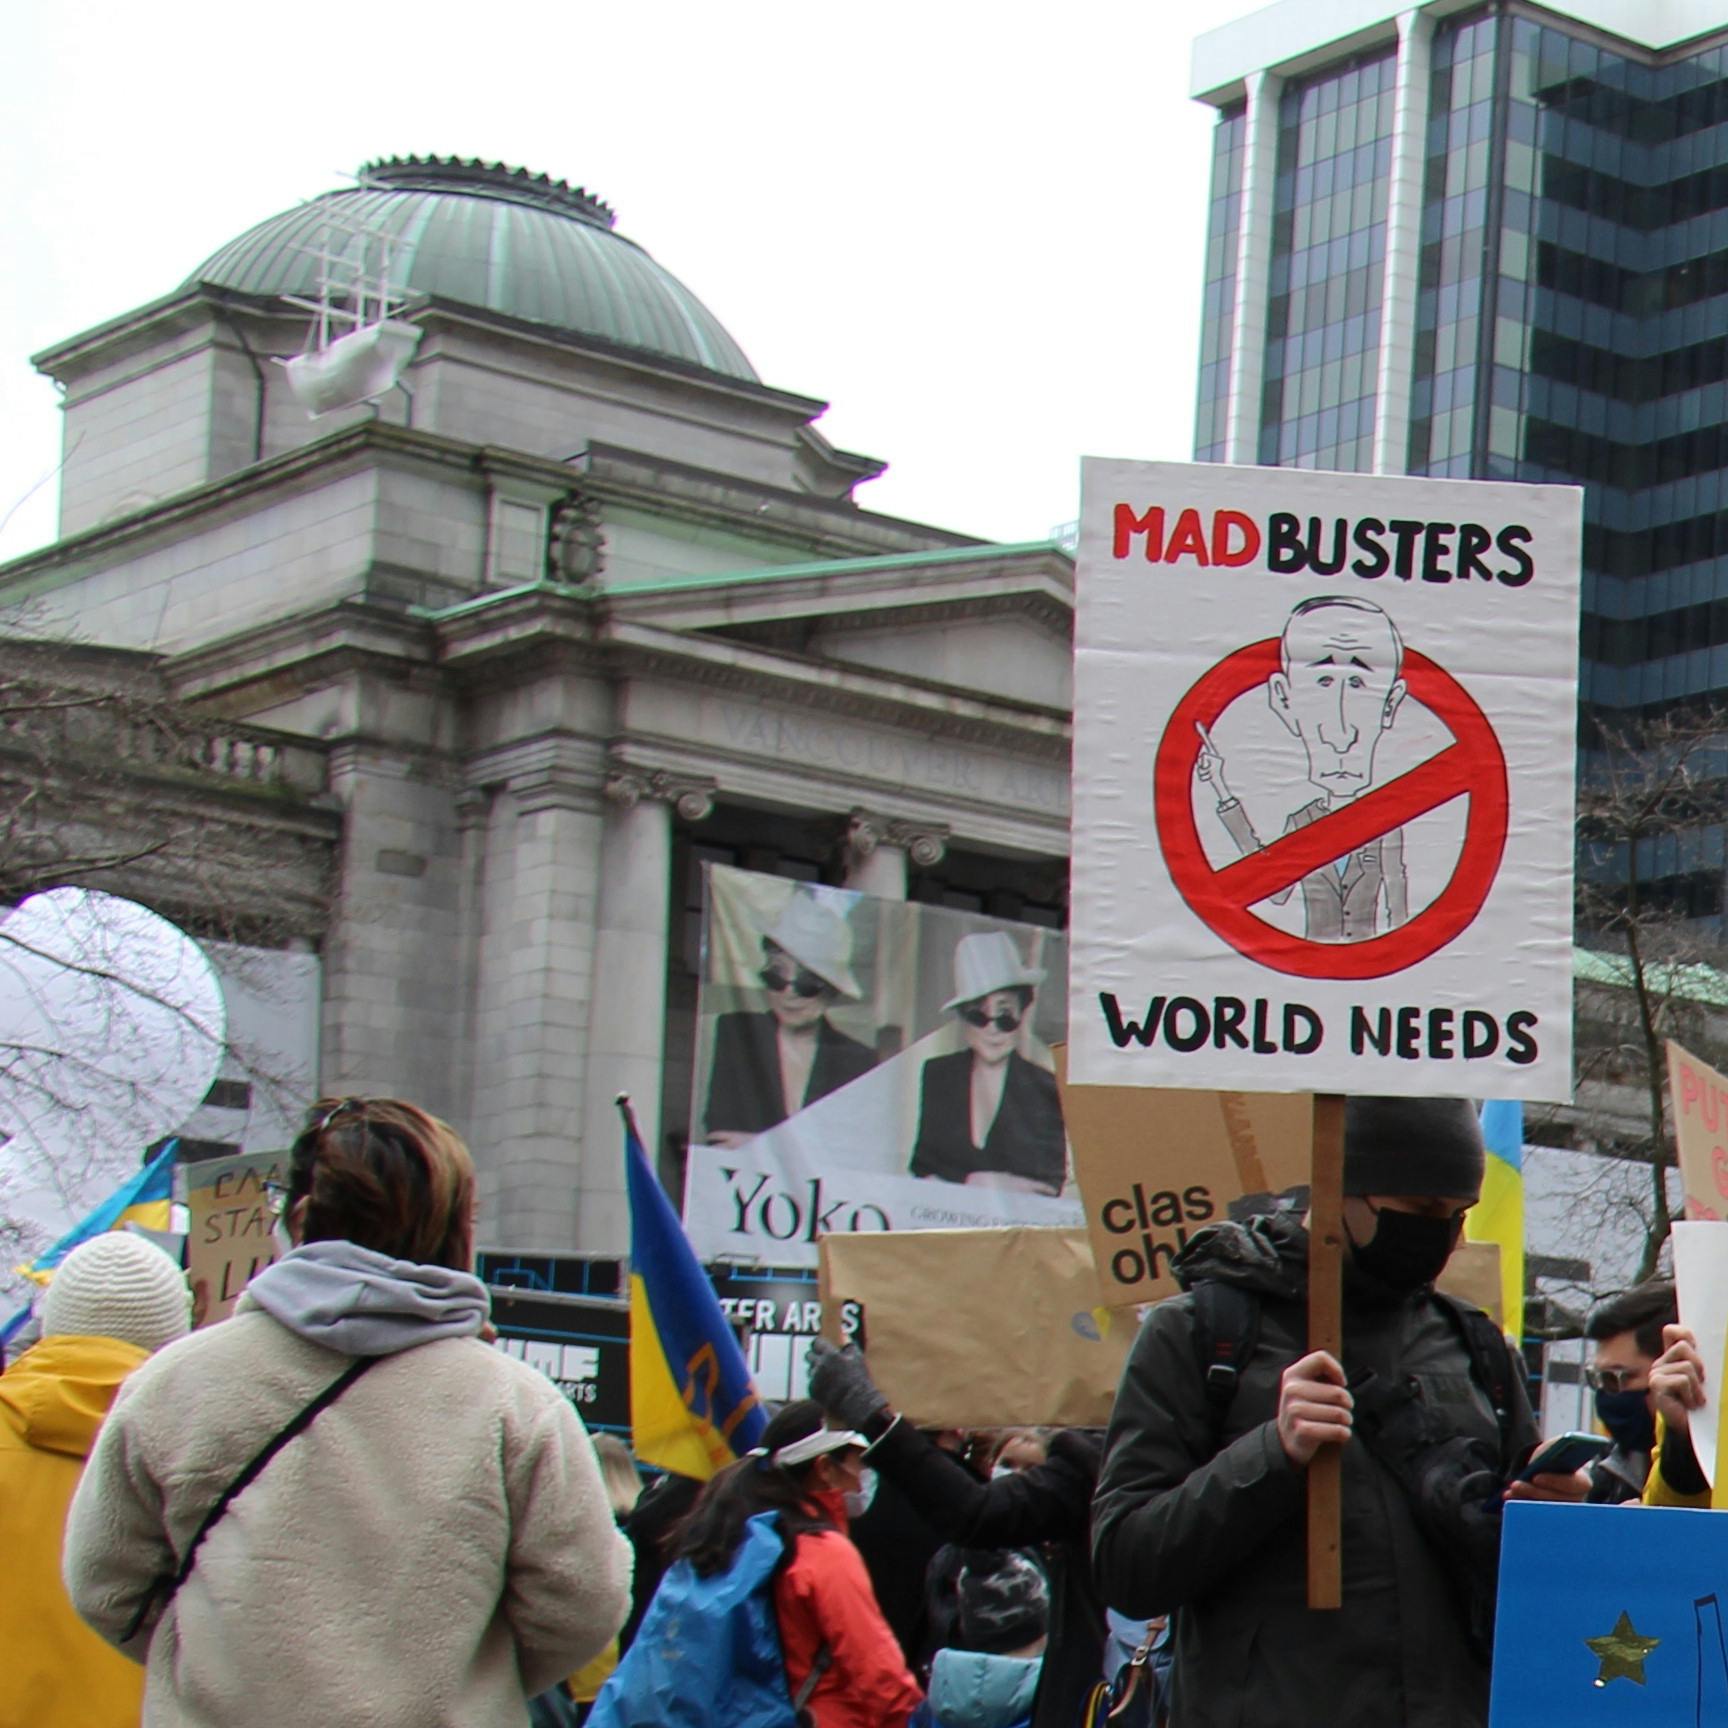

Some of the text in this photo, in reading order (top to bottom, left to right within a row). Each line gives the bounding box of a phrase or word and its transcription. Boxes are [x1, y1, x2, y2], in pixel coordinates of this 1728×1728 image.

[1112, 502, 1535, 587] MADBUSTERS
[1099, 992, 1539, 1064] WORLD NEEDS
[1102, 1183, 1214, 1234] clas
[782, 1301, 860, 1335] ARS
